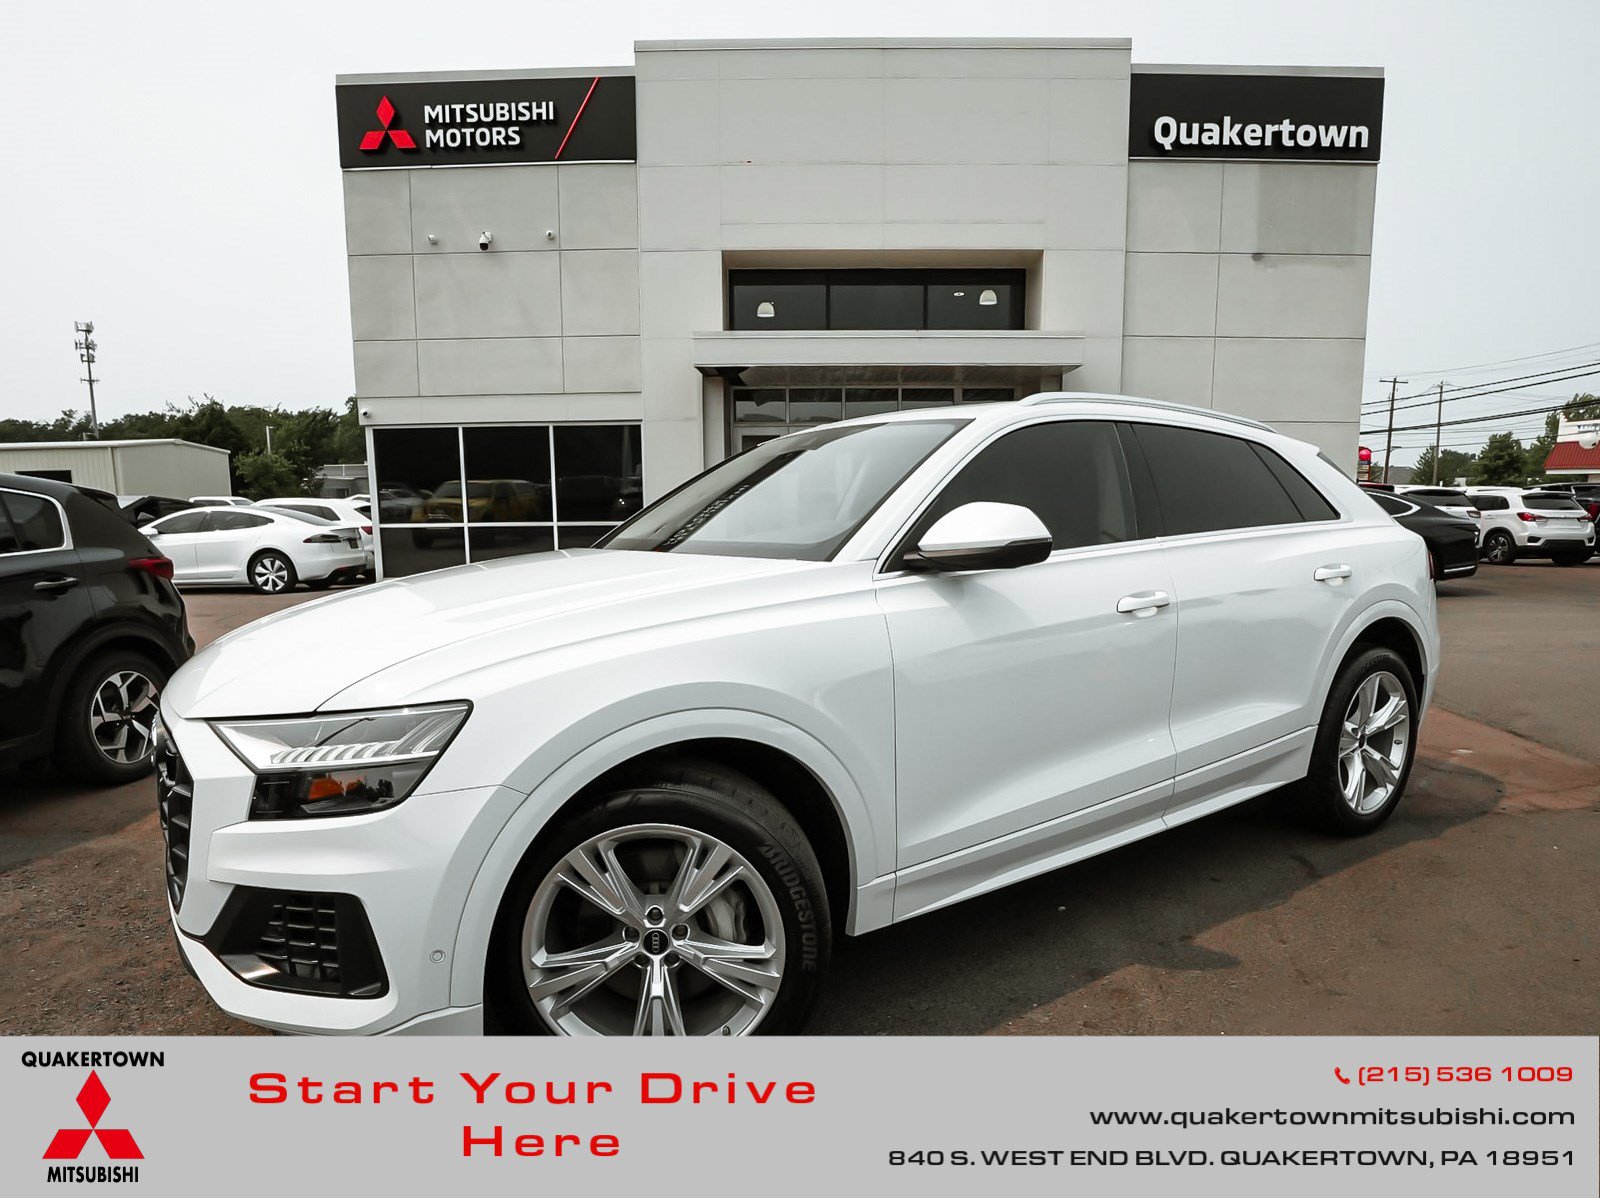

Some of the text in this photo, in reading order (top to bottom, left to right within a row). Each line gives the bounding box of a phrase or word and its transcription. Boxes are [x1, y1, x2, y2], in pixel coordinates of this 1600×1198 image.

[424, 101, 554, 124] MITSUBISHI
[425, 126, 521, 148] MOTORS
[1153, 115, 1369, 150] Quakertown
